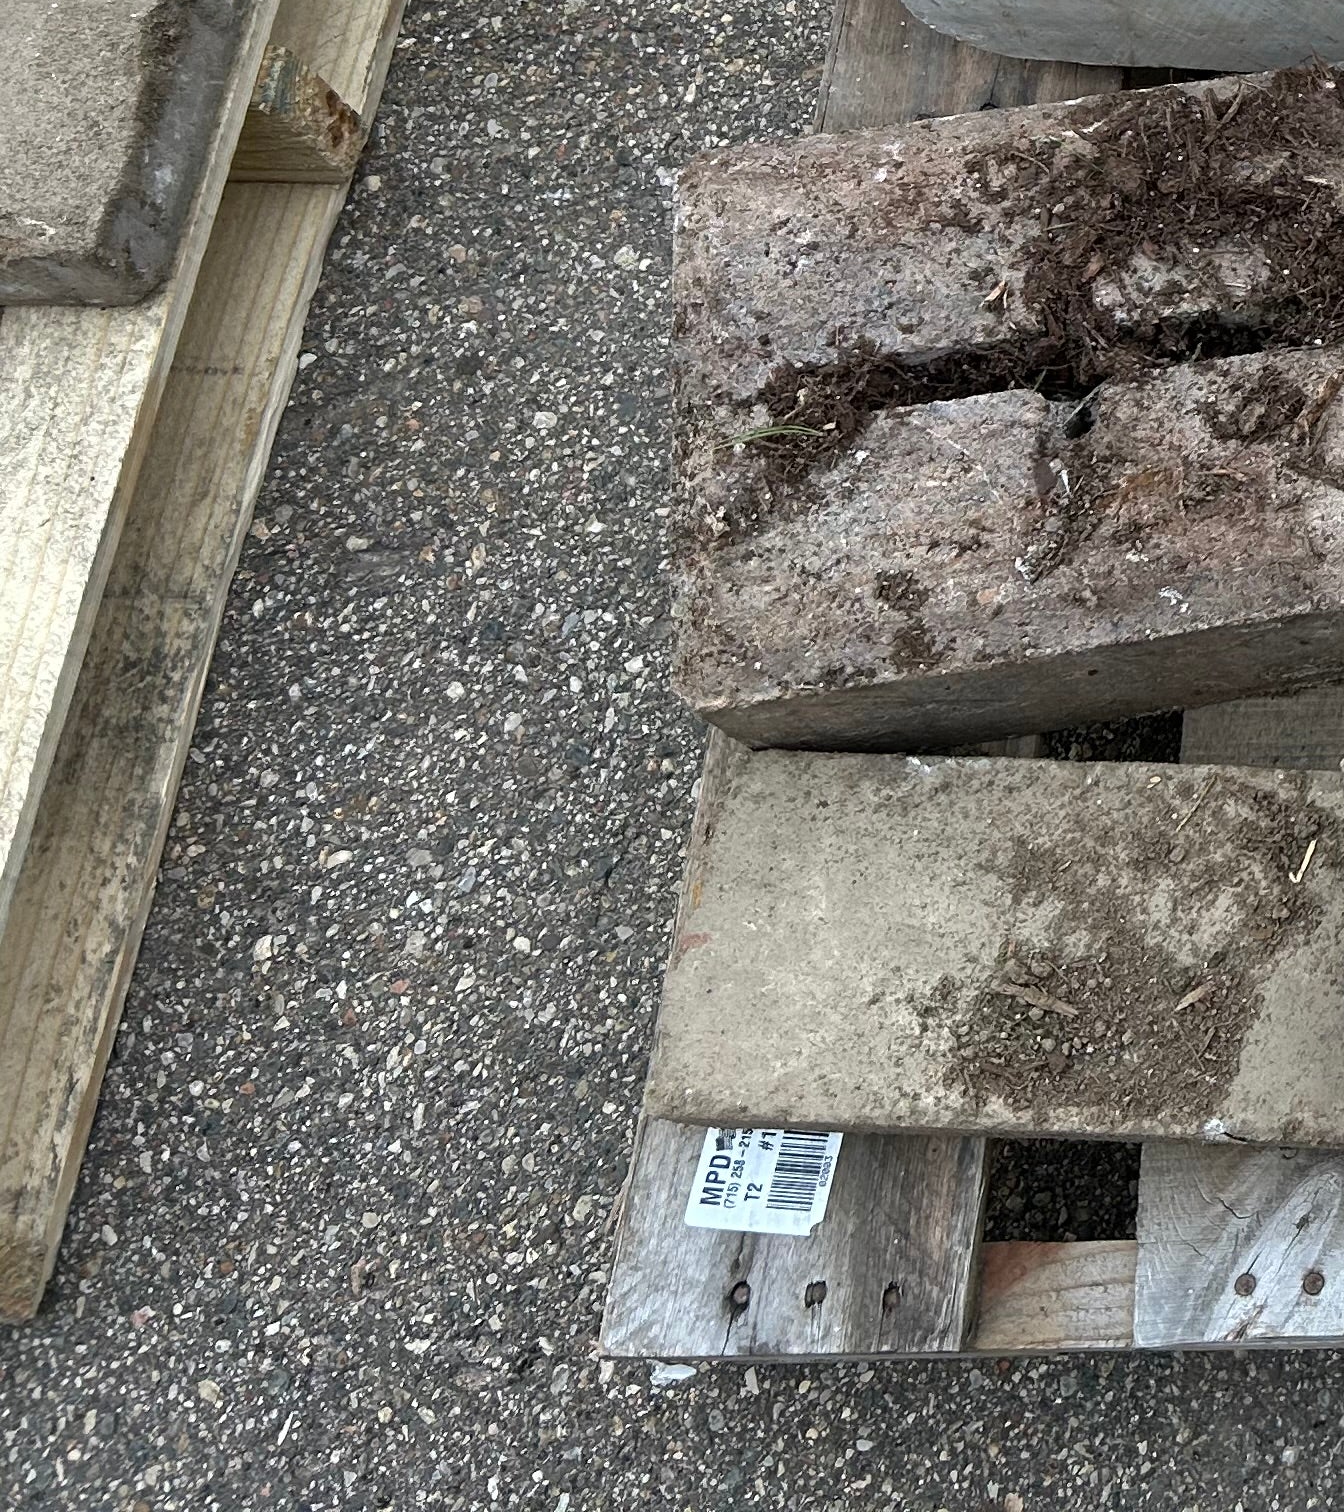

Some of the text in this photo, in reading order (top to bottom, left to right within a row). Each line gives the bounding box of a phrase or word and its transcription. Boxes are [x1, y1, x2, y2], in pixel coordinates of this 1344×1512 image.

[699, 1154, 732, 1206] MPD
[744, 1182, 764, 1202] T2
[723, 1182, 741, 1209] (715)
